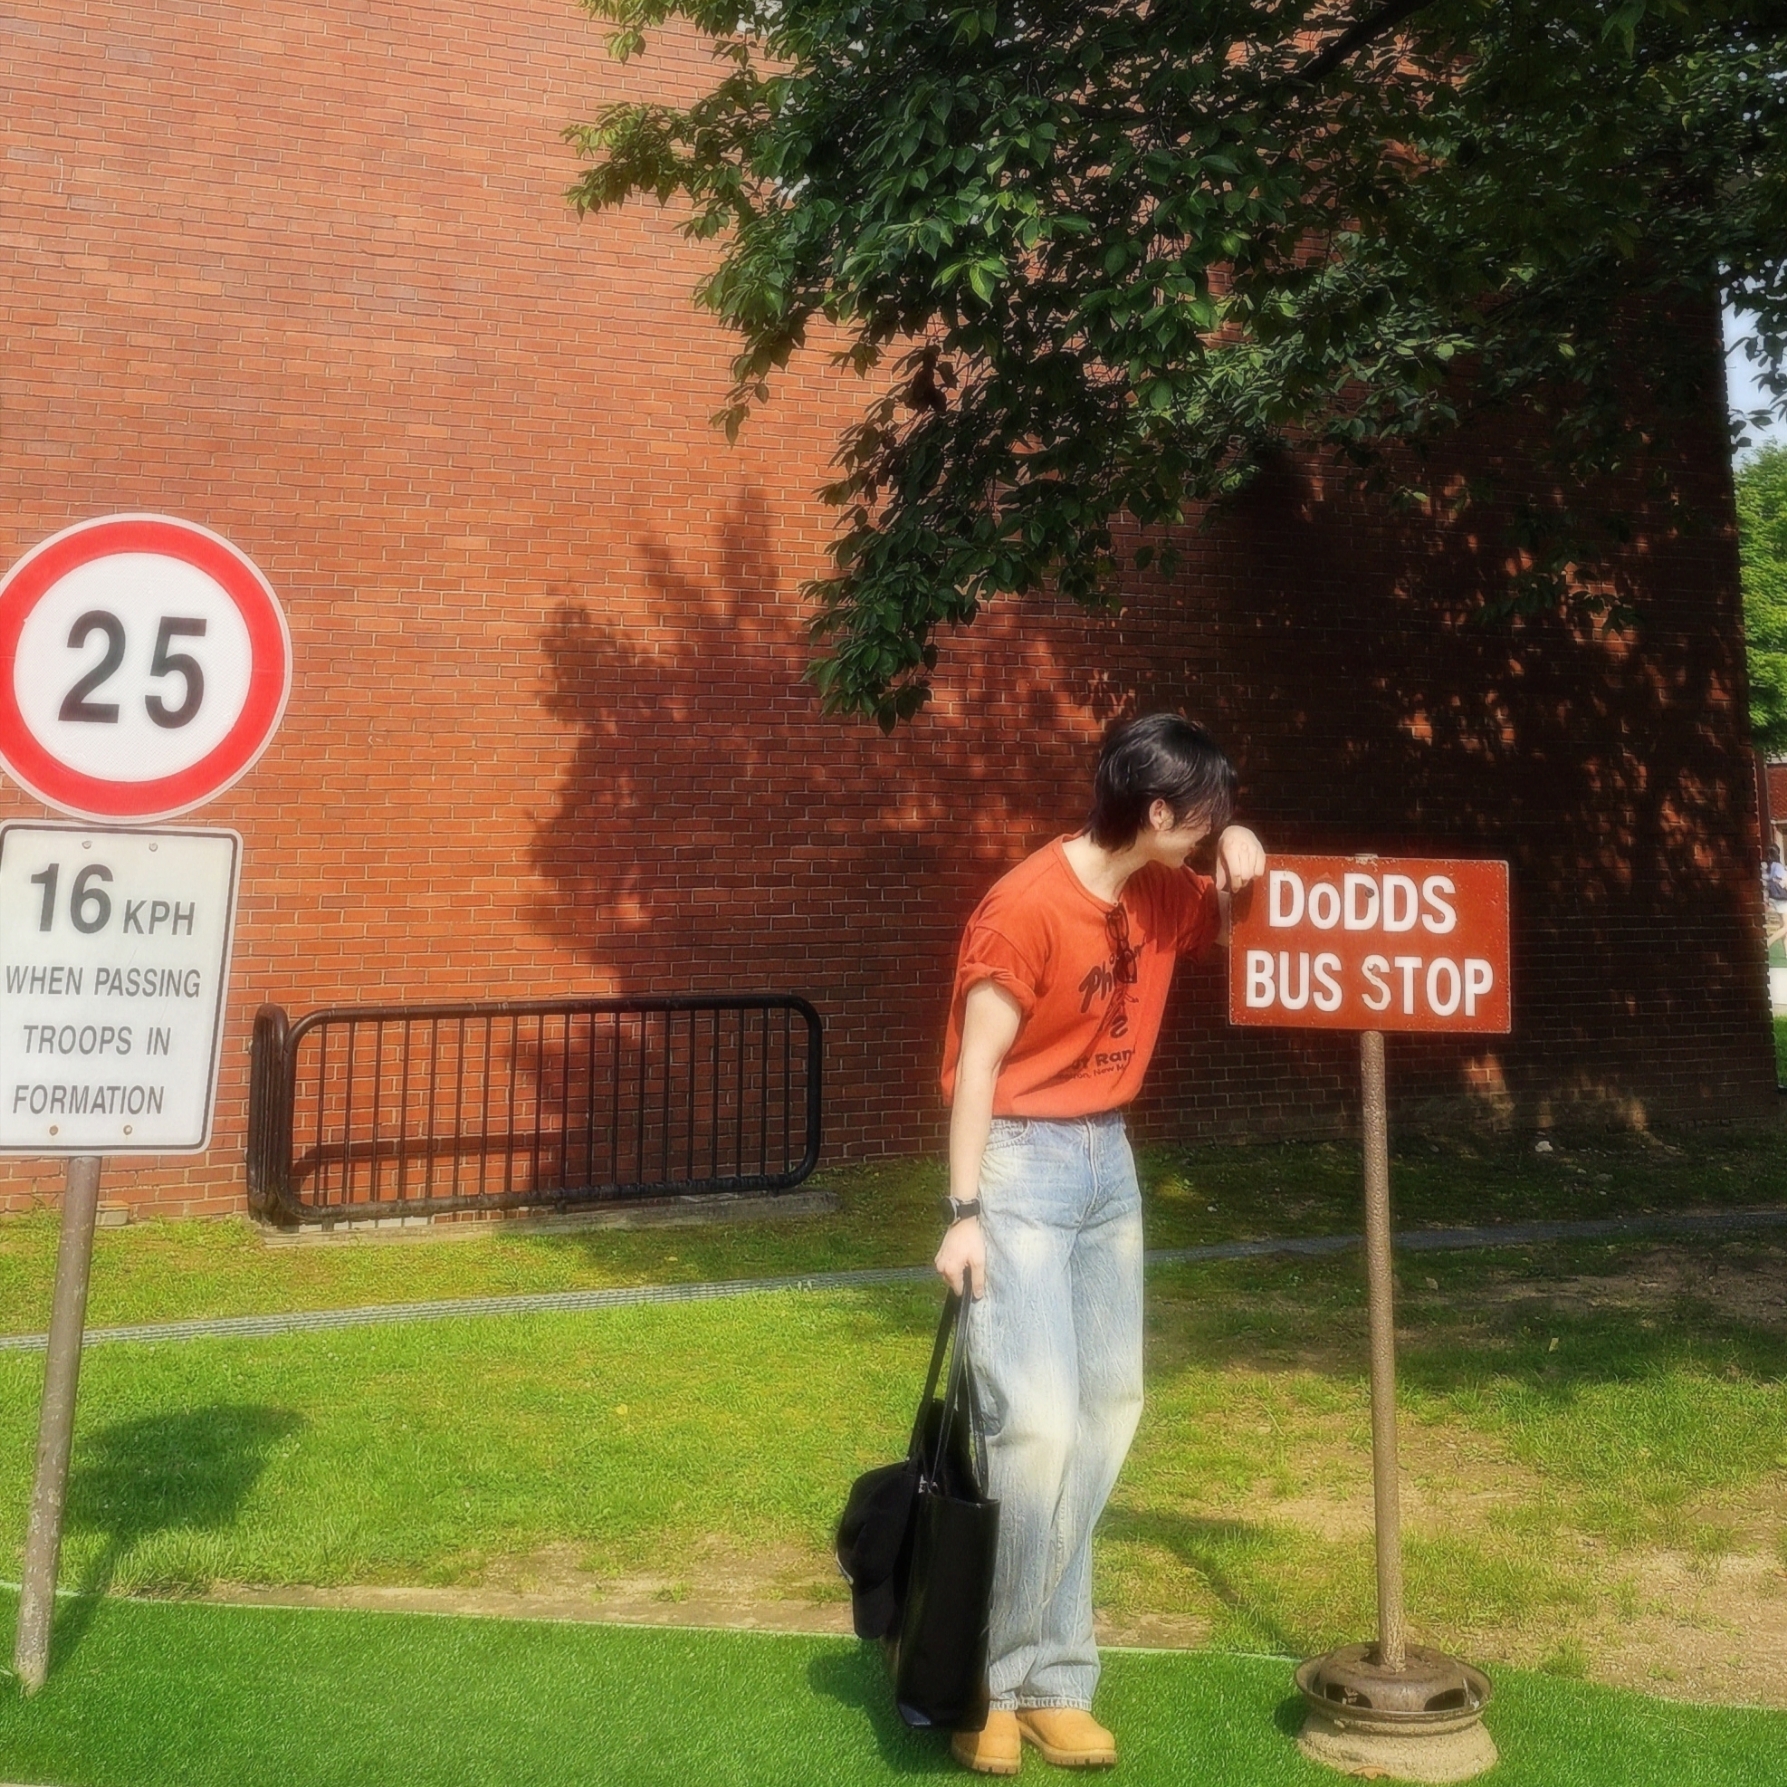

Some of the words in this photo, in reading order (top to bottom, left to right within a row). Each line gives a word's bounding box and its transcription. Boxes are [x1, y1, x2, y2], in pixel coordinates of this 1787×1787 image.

[58, 609, 207, 729] 25
[30, 863, 114, 934] 16
[122, 899, 196, 936] KPH
[1269, 870, 1457, 934] DoDDS
[5, 965, 83, 995] WHEN
[94, 967, 201, 998] PASSING
[1246, 950, 1343, 1012] BUS
[1361, 954, 1494, 1017] STOP
[23, 1024, 133, 1055] TROOPS
[146, 1027, 171, 1056] IN
[13, 1084, 165, 1115] FORMATION
